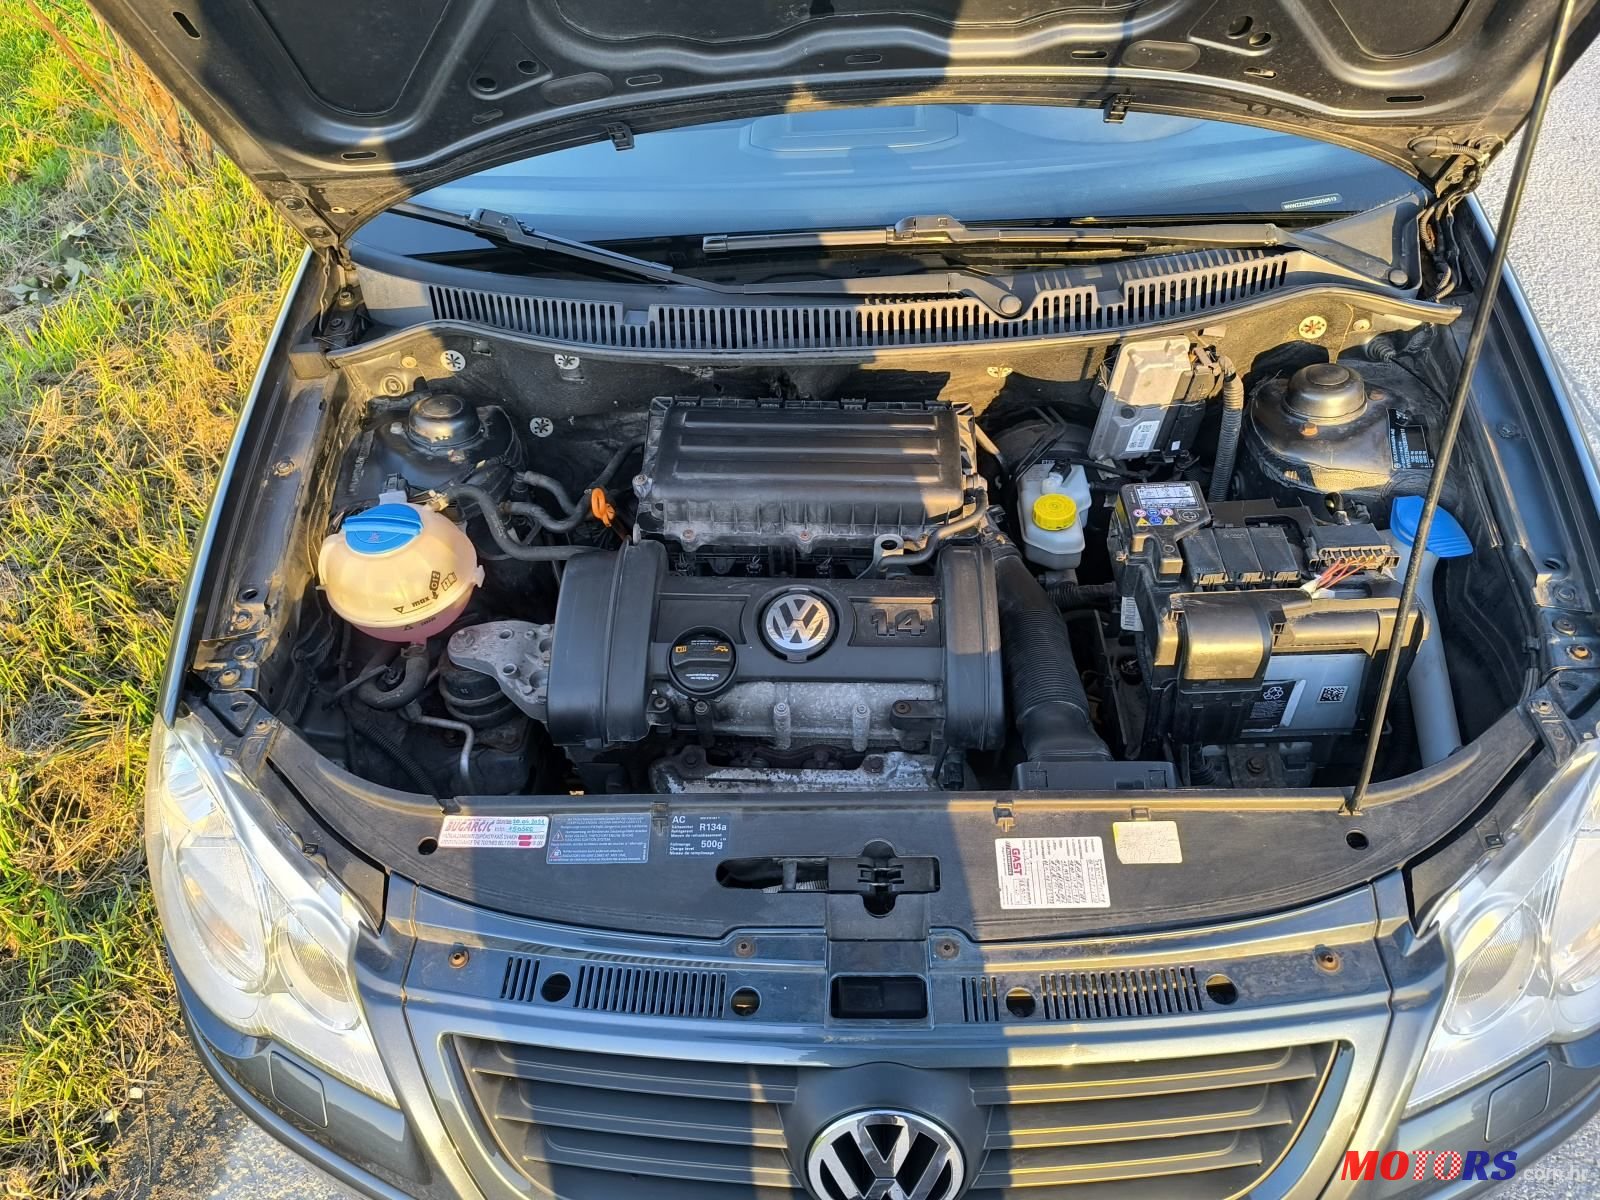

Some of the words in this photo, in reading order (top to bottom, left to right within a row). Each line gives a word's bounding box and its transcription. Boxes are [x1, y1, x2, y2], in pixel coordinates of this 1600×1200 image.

[412, 596, 430, 607] max
[871, 609, 926, 637] 1.4
[672, 816, 686, 824] AC
[699, 823, 727, 831] R134a
[701, 840, 723, 849] 500g
[1011, 848, 1023, 876] GAST
